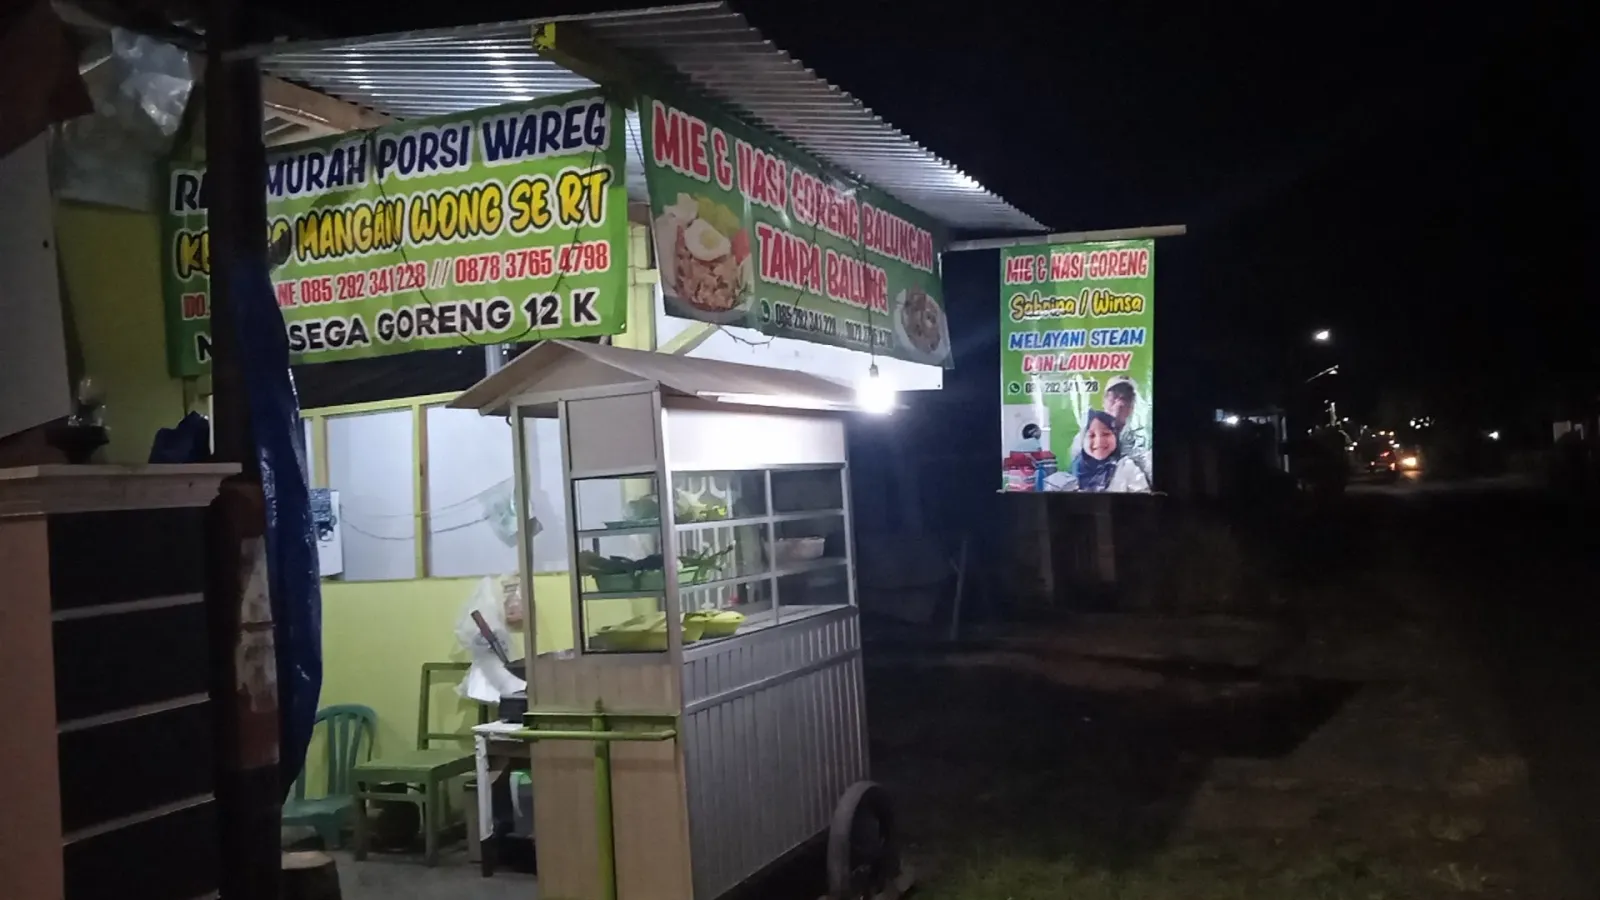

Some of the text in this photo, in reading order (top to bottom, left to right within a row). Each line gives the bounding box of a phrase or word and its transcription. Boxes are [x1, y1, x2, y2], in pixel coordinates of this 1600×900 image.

[378, 125, 470, 180] PORSI
[482, 101, 607, 160] WAREG
[296, 197, 405, 262] MANGAN
[410, 181, 502, 244] WONG
[509, 177, 549, 232] SE
[556, 170, 612, 225] RT
[653, 104, 933, 272] MIE & NASI GORENG BALUNGAN
[301, 277, 333, 303] 085
[455, 253, 500, 285] 0878
[505, 248, 553, 279] 3765
[558, 243, 608, 274] 4798
[757, 224, 888, 314] TANPA BALUNG
[1006, 256, 1033, 283] MIE
[1051, 253, 1084, 280] NASI
[1089, 250, 1148, 279] GORENG
[288, 290, 598, 352] SEGA GORENG 12 K
[1079, 289, 1090, 317] /
[1092, 289, 1144, 317] Winsa
[1010, 328, 1144, 350] MELAYANI STEAM
[1060, 352, 1131, 371] LAUNDRY
